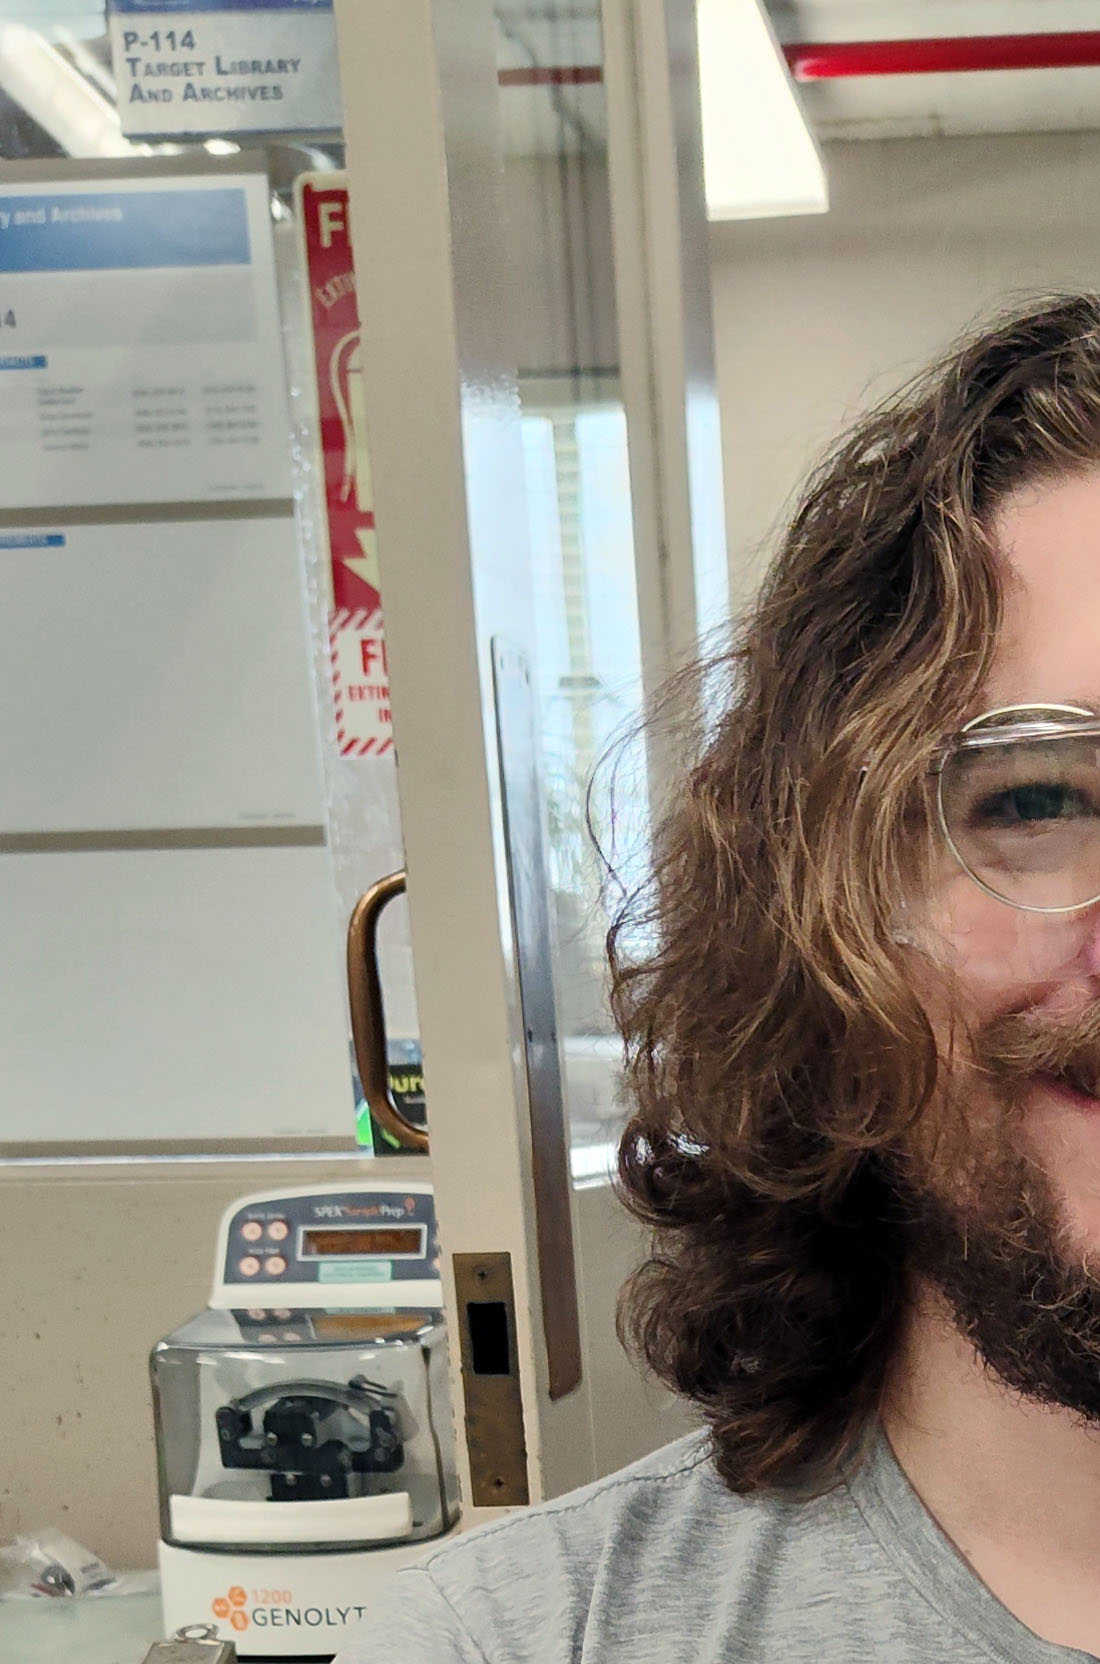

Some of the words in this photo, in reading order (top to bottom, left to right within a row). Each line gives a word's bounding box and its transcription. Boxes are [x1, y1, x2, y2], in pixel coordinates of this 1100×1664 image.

[123, 30, 196, 51] P-114
[360, 639, 388, 676] FI
[252, 1588, 293, 1604] 1200
